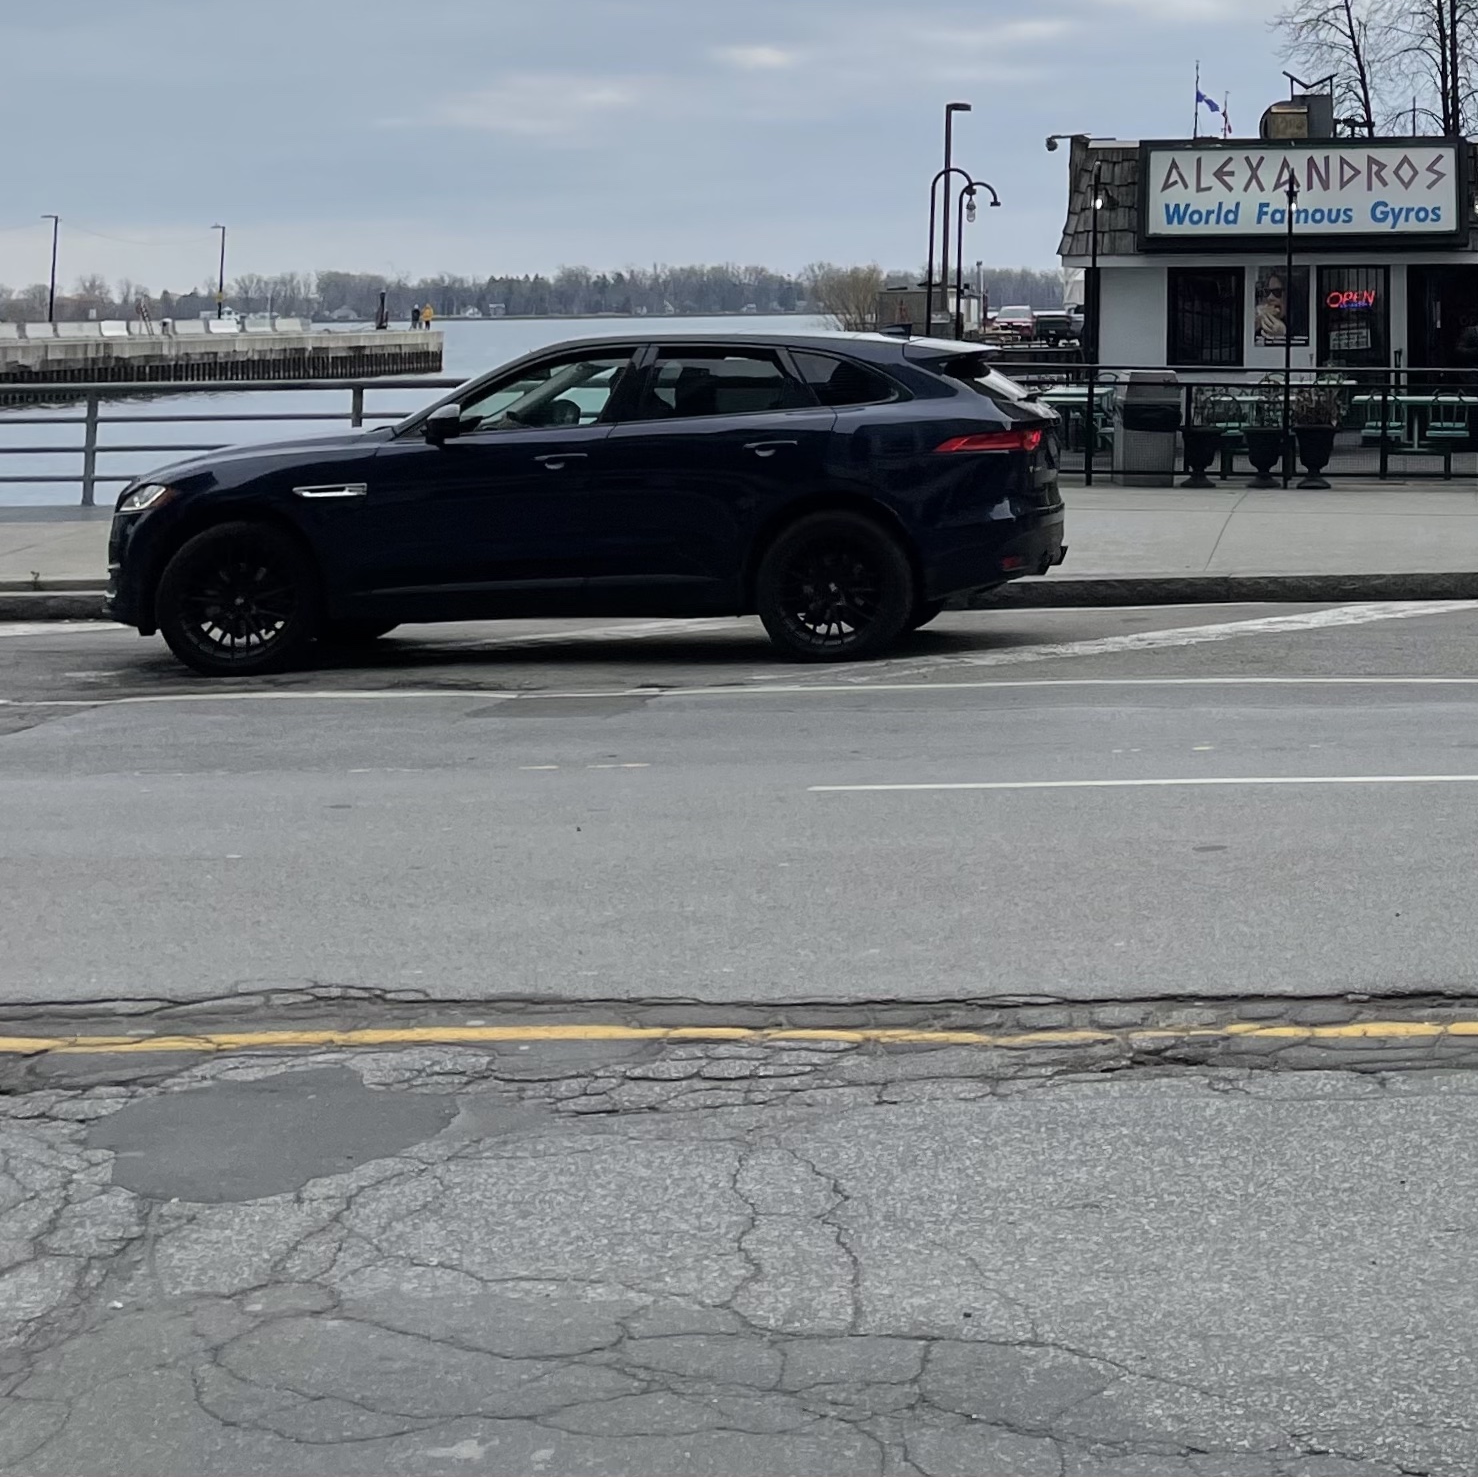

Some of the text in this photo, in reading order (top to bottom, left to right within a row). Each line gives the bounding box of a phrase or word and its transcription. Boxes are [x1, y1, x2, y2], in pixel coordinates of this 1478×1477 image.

[1160, 153, 1447, 193] ALEXANDROS
[1164, 200, 1442, 229] World Famous Gyros
[1326, 289, 1376, 308] OPEN
